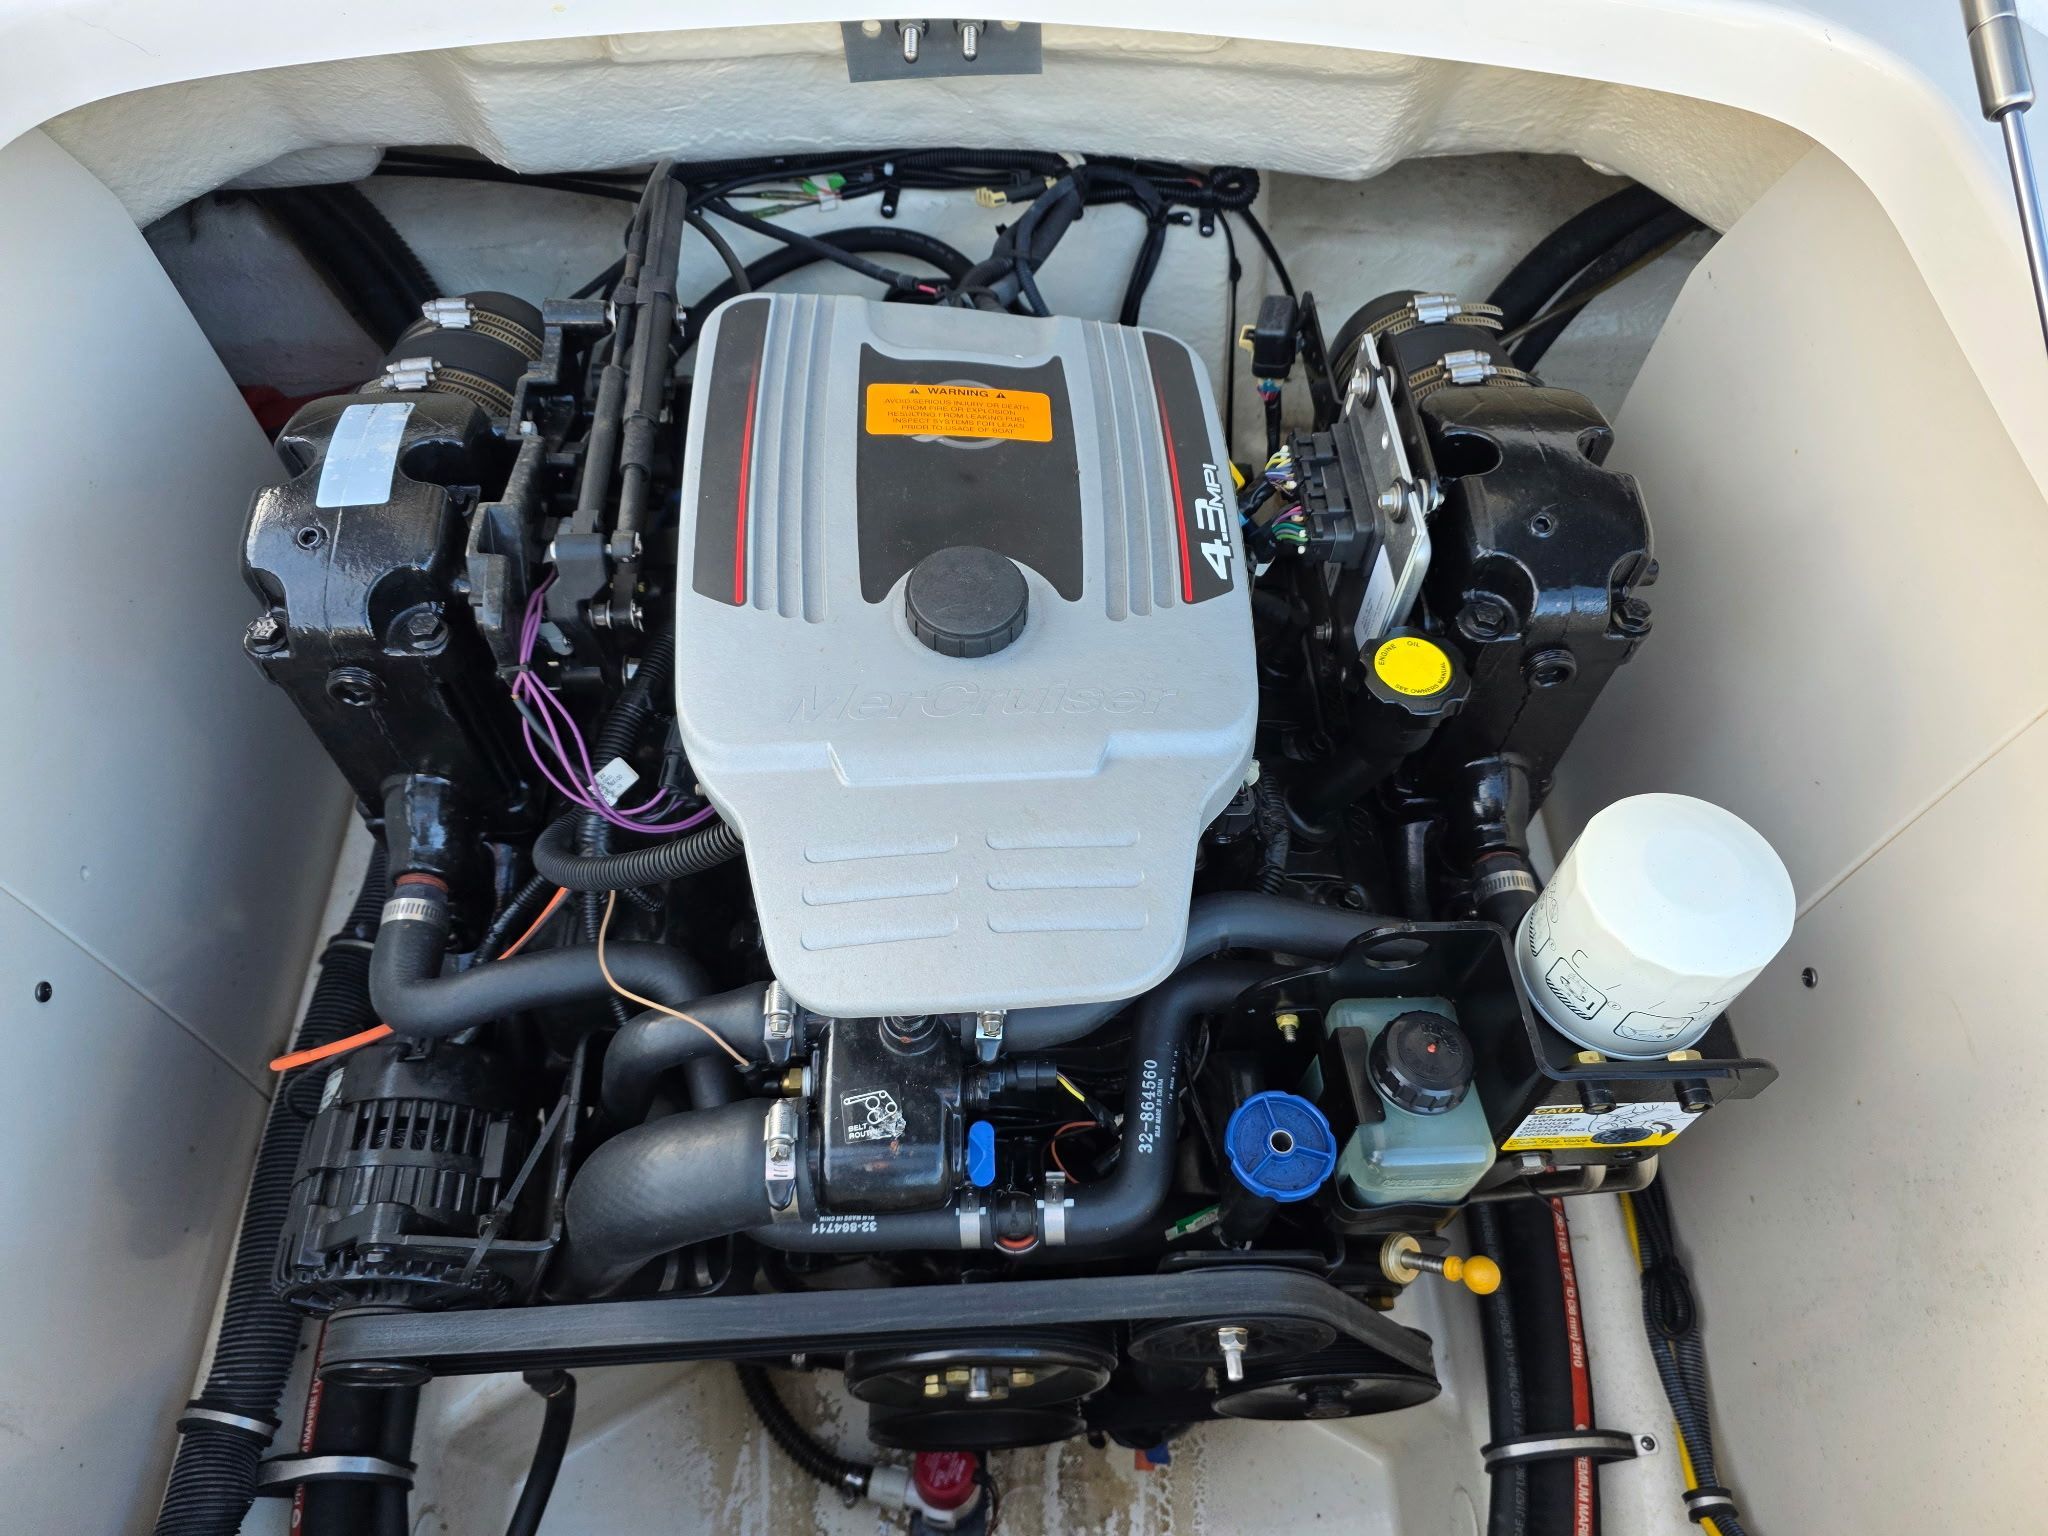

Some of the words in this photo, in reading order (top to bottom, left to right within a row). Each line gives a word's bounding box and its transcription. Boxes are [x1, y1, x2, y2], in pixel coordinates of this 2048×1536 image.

[928, 387, 989, 397] WARNING
[966, 407, 1016, 416] EXPLOSION
[1379, 643, 1397, 666] ENGINE
[1406, 640, 1420, 648] OIL
[1395, 684, 1409, 692] SEE
[1439, 662, 1447, 685] MANUAL
[785, 679, 1179, 724] MerCruiser
[1156, 1078, 1164, 1097] CHINA
[1138, 1059, 1158, 1154] 32-864560
[1155, 1108, 1163, 1124] MADE
[1534, 1107, 1584, 1115] CAUTI
[848, 1122, 868, 1133] BELT
[811, 1221, 878, 1234] 32-864711
[1573, 1343, 1583, 1368] 2010
[1576, 1456, 1590, 1503] REMIUM
[1577, 1503, 1590, 1536] MARI
